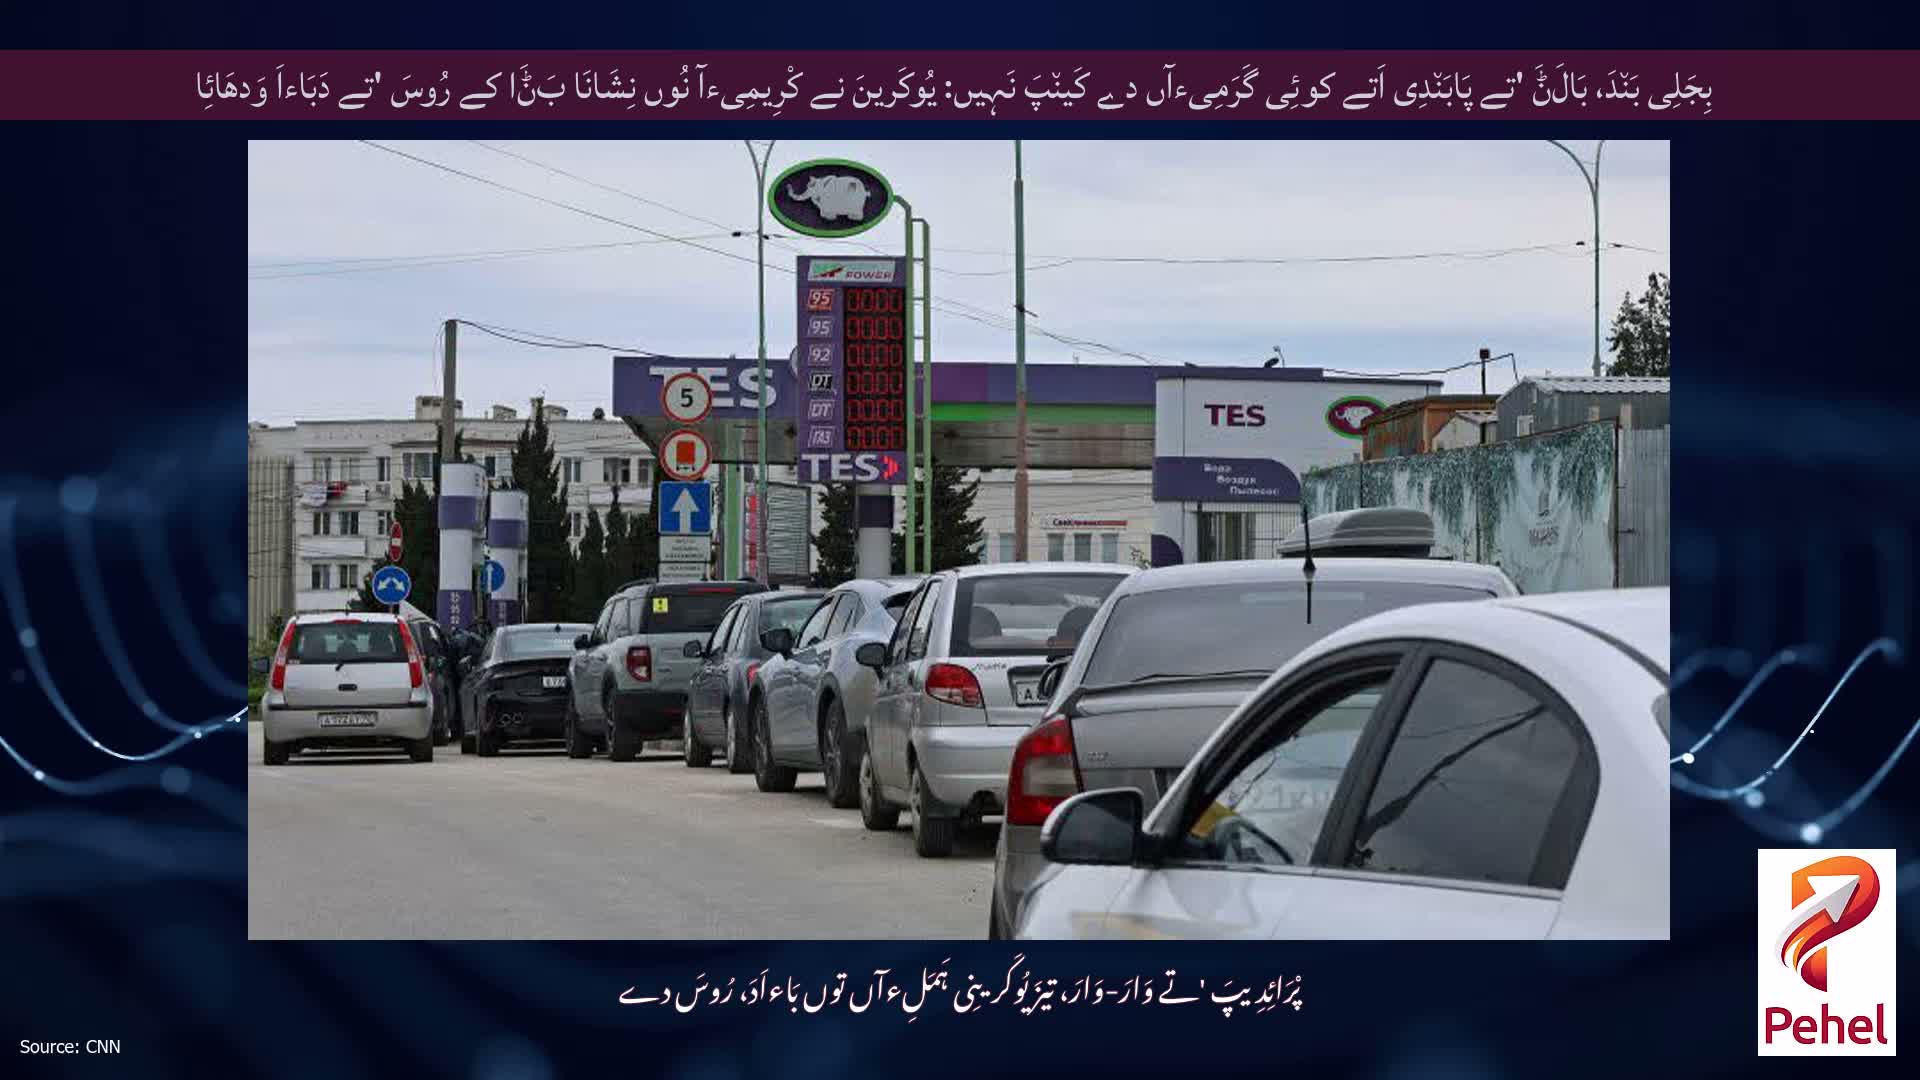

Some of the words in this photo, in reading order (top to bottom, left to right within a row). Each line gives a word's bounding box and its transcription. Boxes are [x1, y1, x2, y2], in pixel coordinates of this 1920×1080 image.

[812, 292, 831, 305] 95
[812, 320, 831, 335] 95
[812, 348, 831, 362] 92
[650, 366, 777, 409] TES
[680, 388, 694, 407] 5
[1204, 404, 1266, 427] TES
[801, 453, 880, 481] TES
